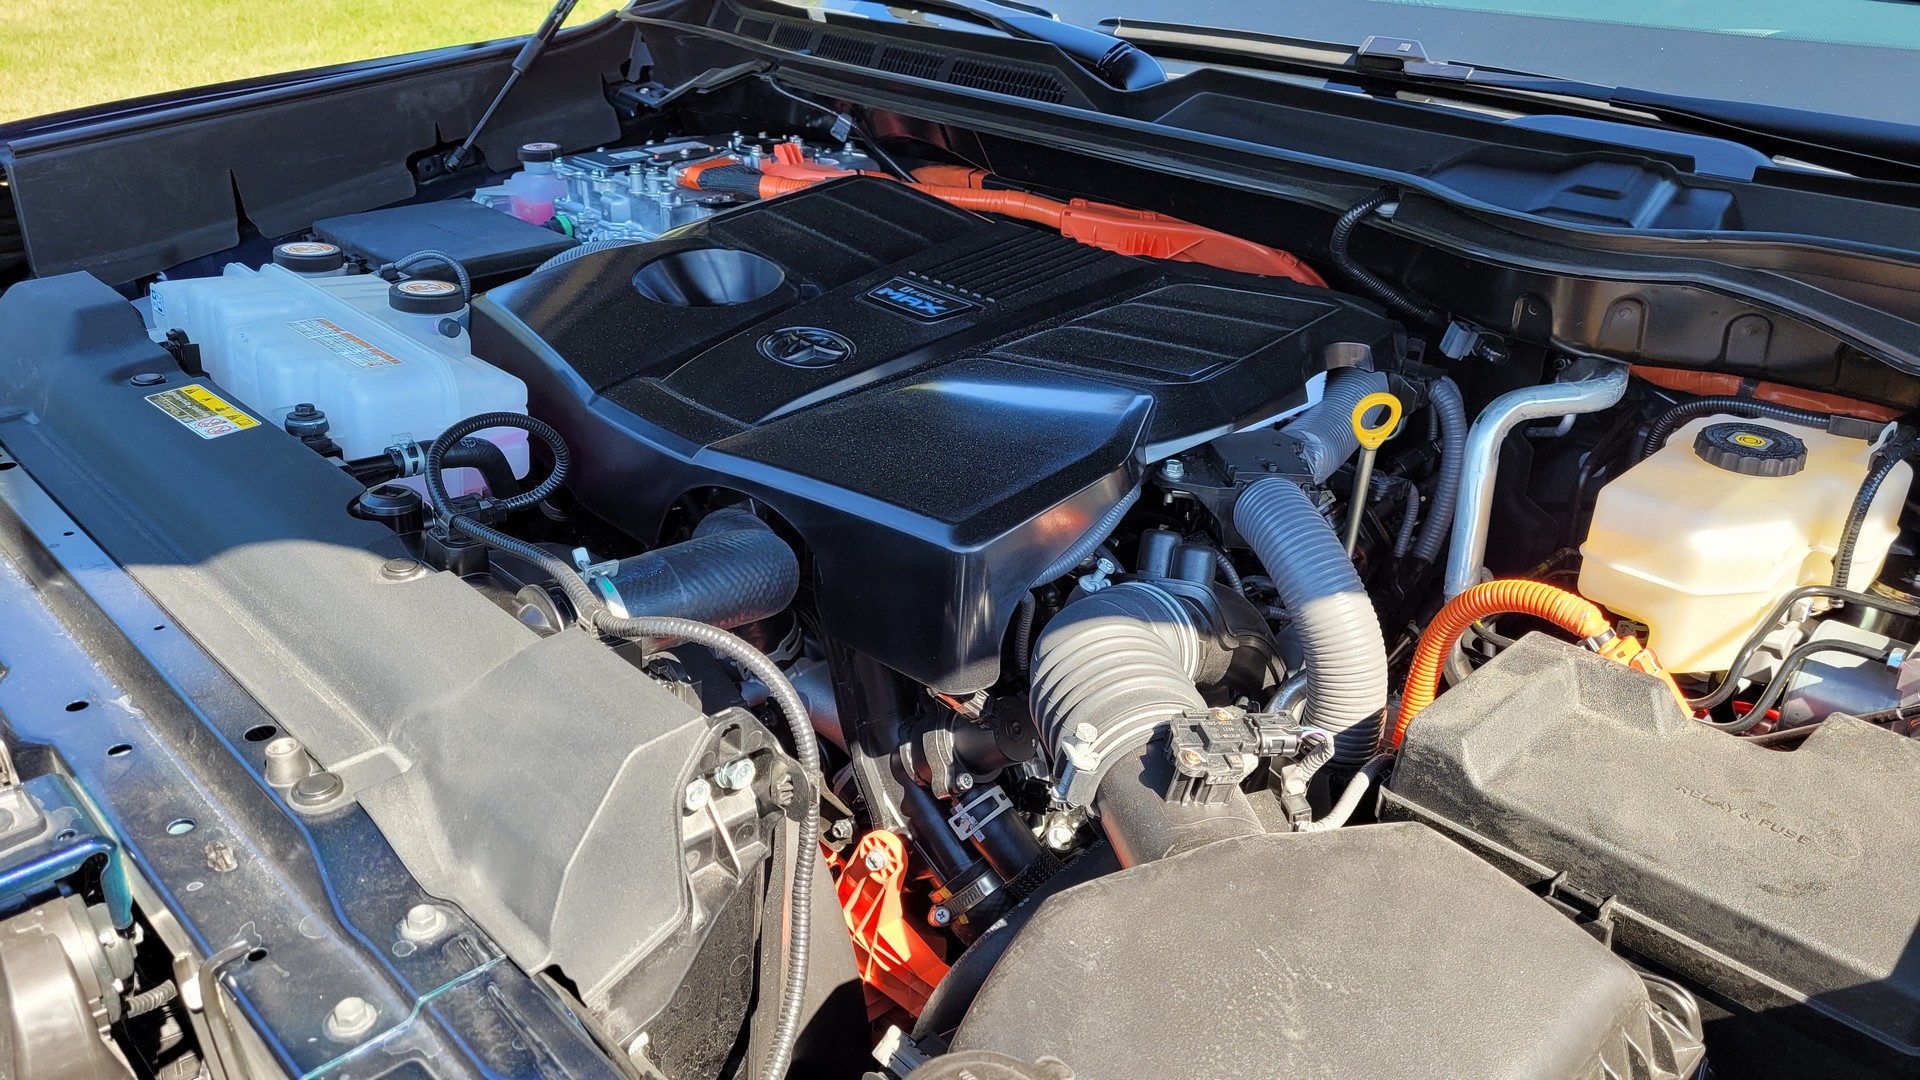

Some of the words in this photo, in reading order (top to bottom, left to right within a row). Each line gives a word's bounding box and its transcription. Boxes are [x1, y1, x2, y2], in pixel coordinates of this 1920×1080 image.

[874, 287, 948, 315] MAX
[1675, 783, 1735, 814] RELAY
[1739, 811, 1753, 822] &
[1758, 818, 1812, 846] FUSE
